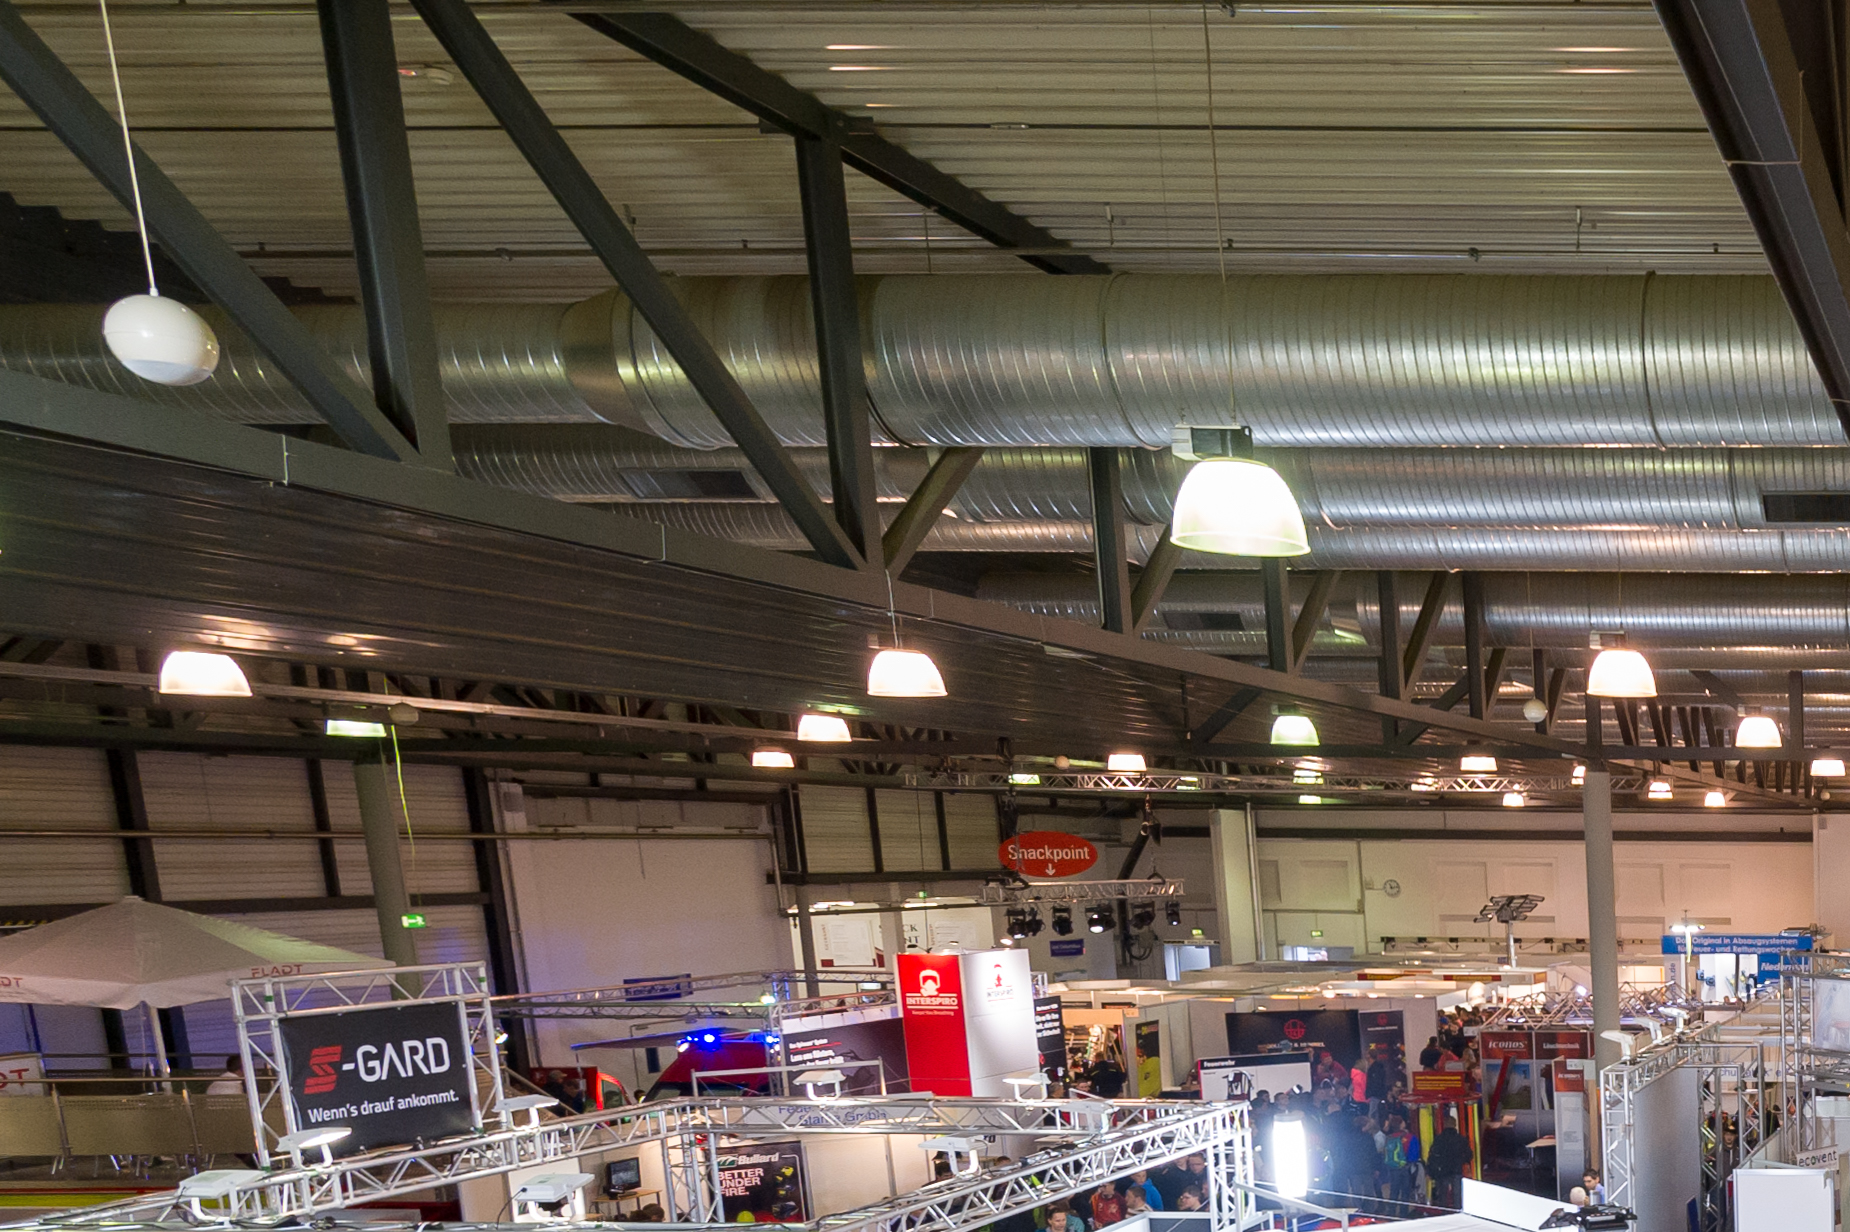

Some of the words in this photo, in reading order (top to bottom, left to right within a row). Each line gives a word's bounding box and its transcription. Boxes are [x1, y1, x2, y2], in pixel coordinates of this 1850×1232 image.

[1007, 844, 1090, 863] Snackpoint
[905, 996, 958, 1006] INTERSPIRO
[304, 1036, 451, 1095] S-GARD
[307, 1103, 358, 1123] Wenn's
[360, 1096, 395, 1117] drauf
[397, 1089, 460, 1111] ankommt.
[738, 1152, 780, 1166] Bullard
[1799, 1150, 1838, 1167] ecovent
